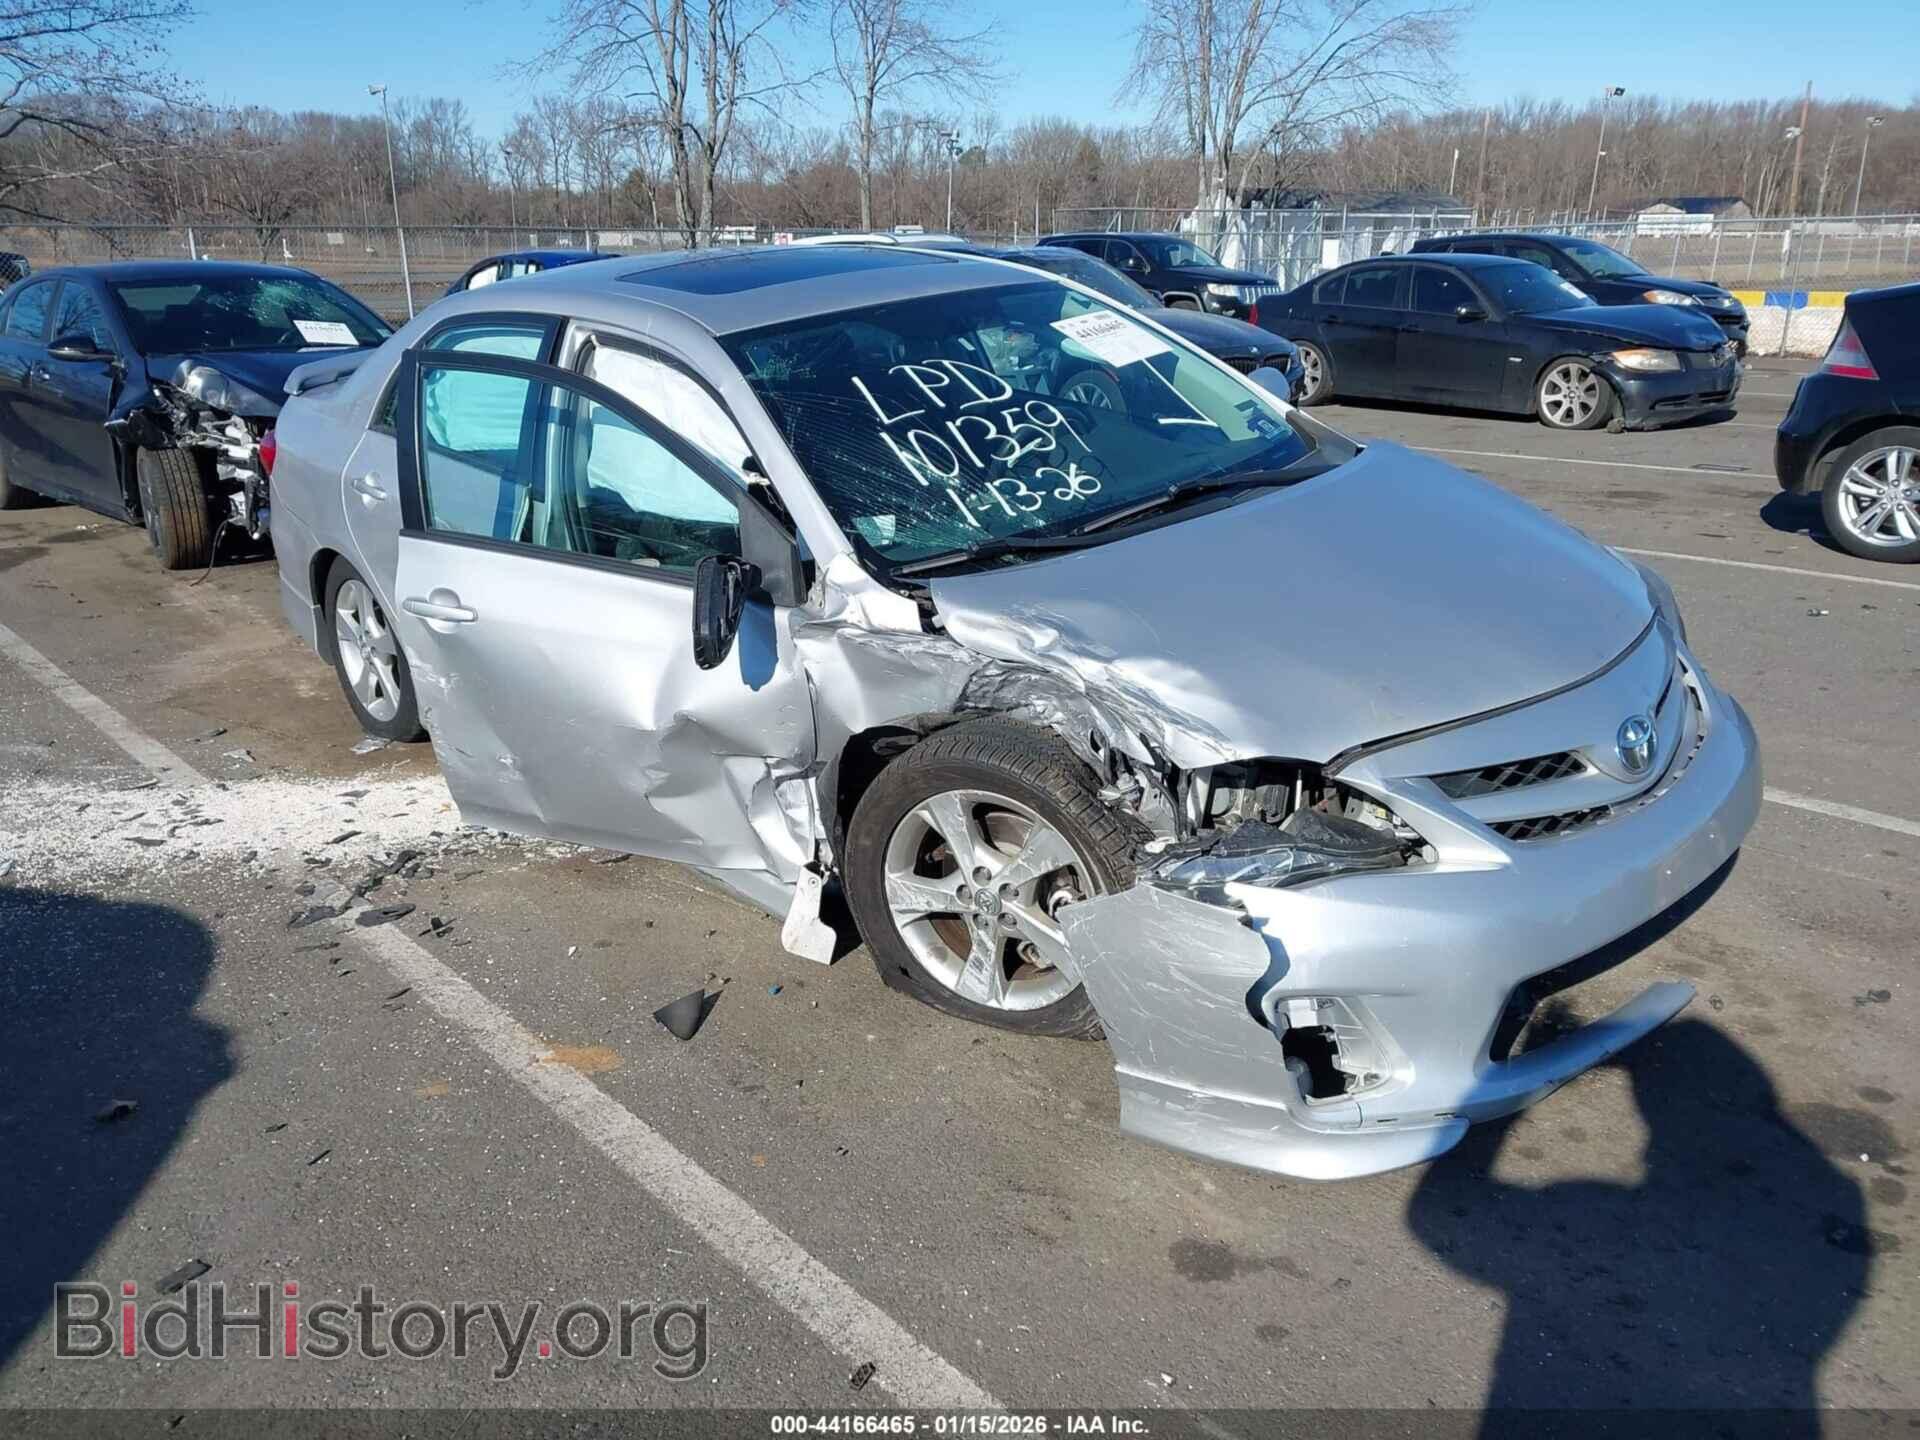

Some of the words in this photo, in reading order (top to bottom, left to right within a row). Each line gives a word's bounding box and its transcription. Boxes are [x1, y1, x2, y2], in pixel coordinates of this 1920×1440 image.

[851, 359, 1013, 424] LPD
[879, 400, 1092, 486] 101359
[946, 462, 1101, 527] 1-13-26
